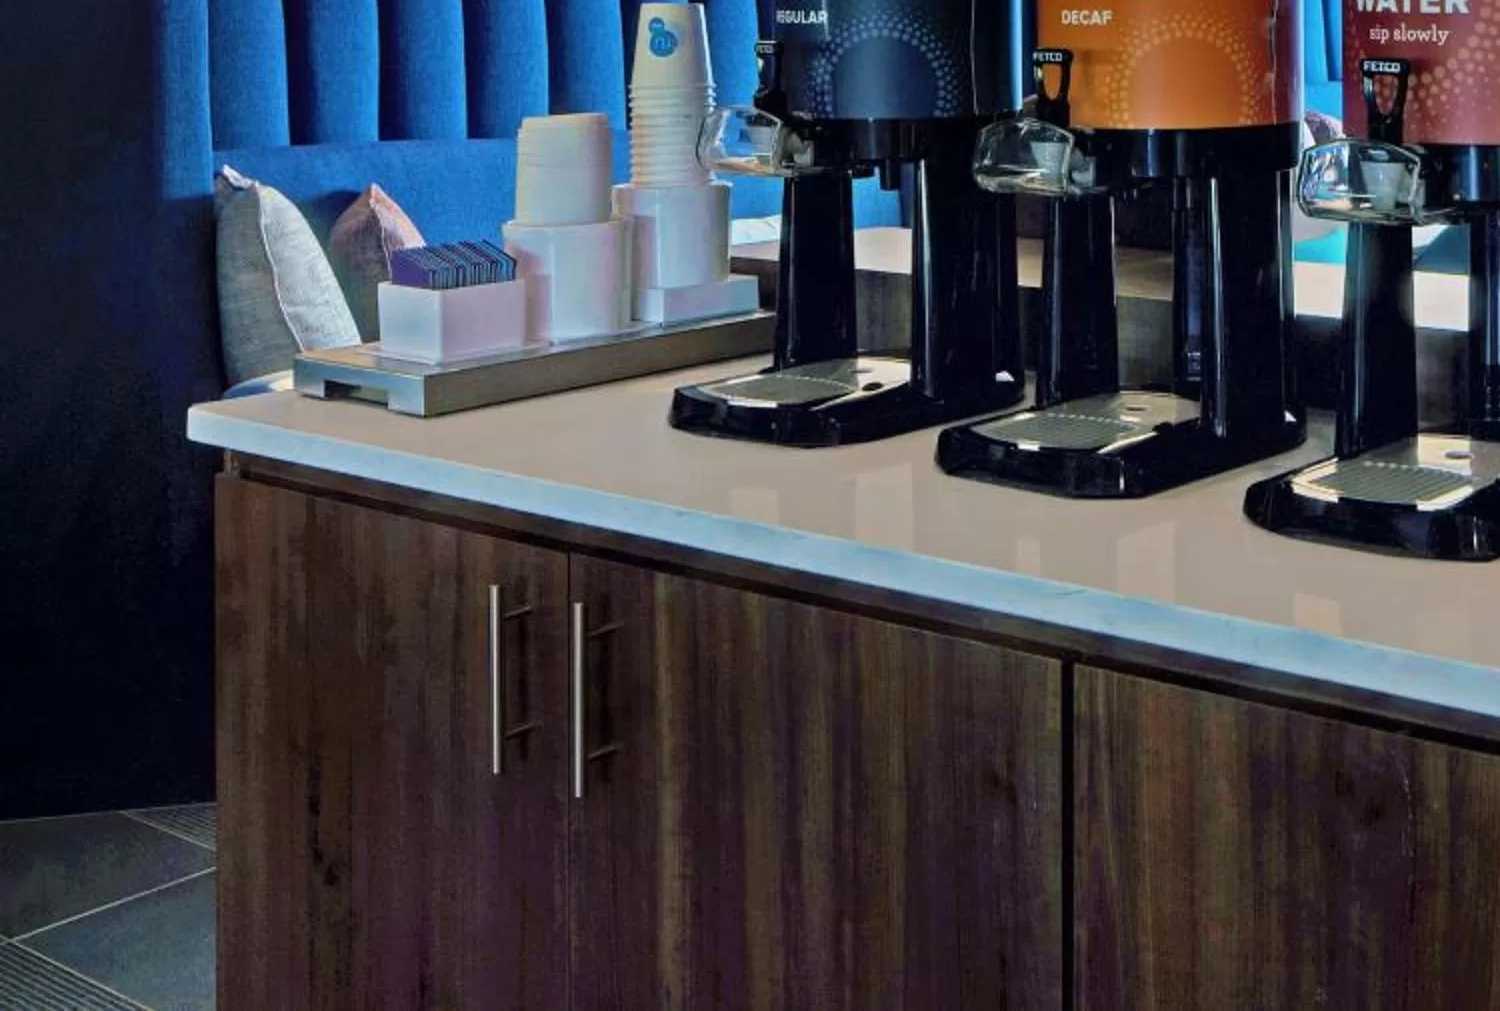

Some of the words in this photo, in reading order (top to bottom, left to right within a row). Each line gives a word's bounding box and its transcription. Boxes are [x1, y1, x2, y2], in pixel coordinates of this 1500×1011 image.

[1061, 10, 1113, 25] DECAF
[1369, 24, 1390, 44] sip
[1393, 22, 1450, 45] slowly
[1363, 61, 1401, 72] FETCO
